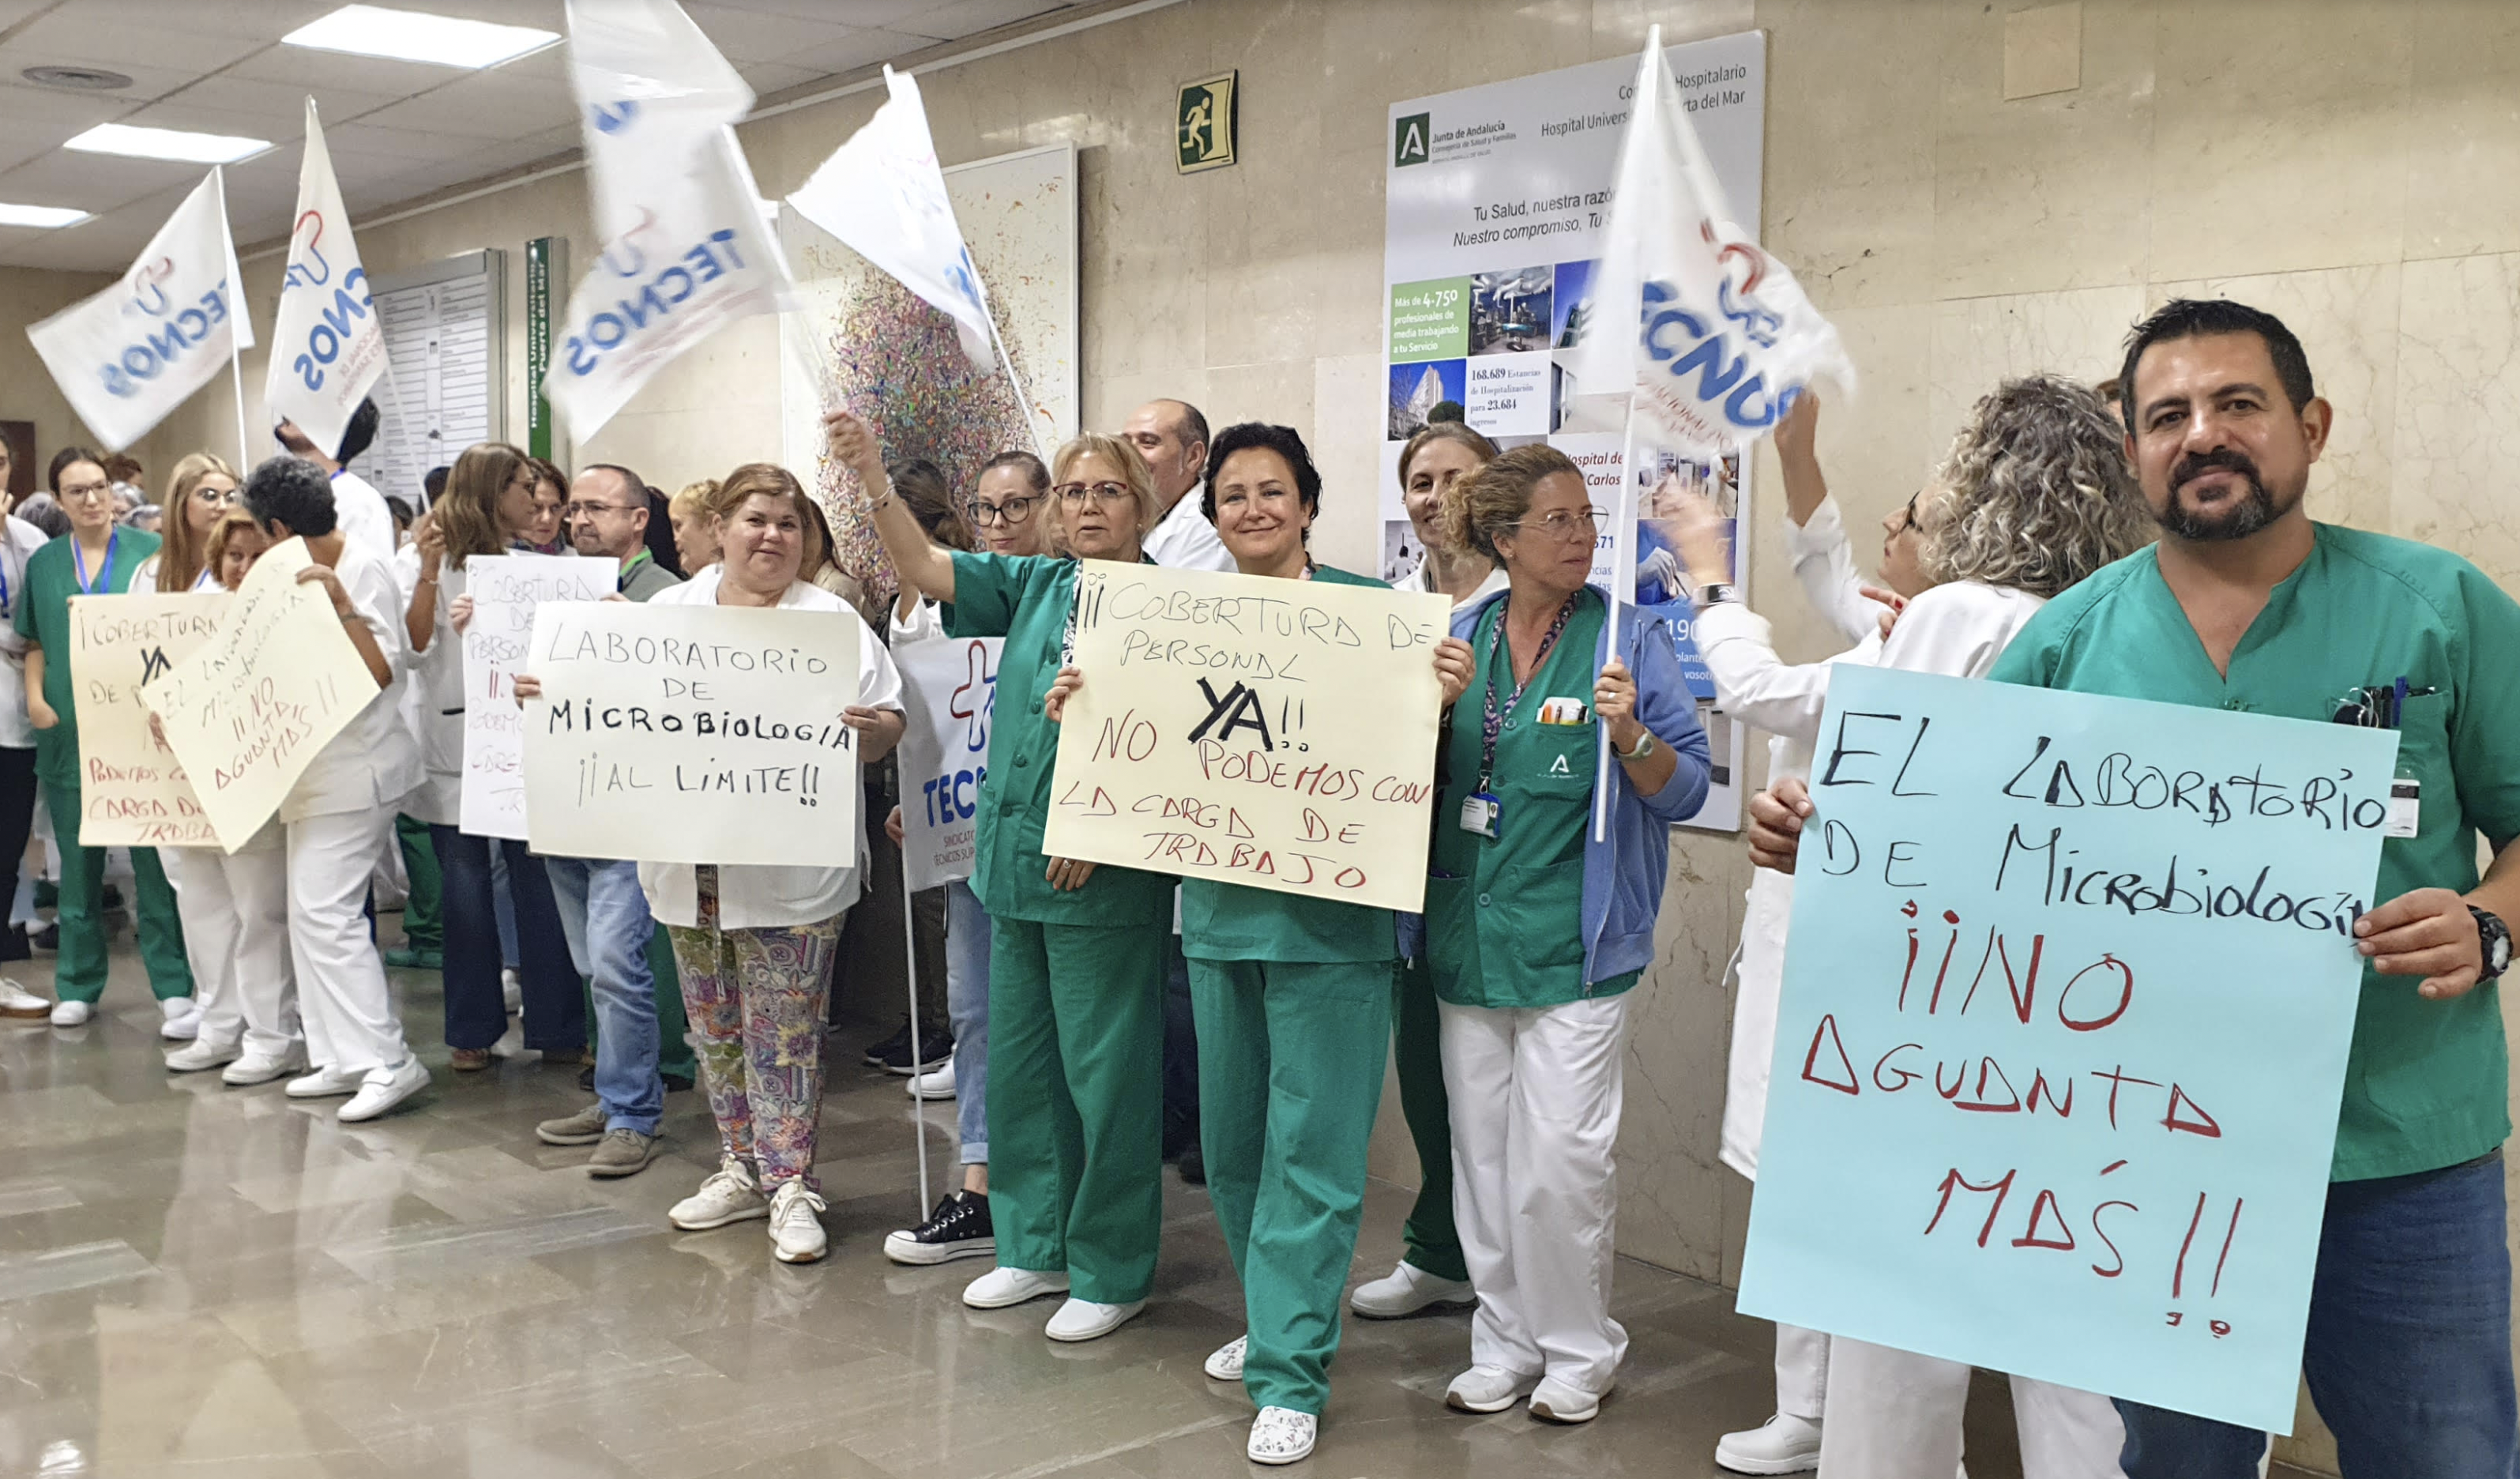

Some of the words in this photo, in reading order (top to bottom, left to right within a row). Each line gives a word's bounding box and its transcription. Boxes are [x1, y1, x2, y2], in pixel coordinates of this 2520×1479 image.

[1541, 115, 1585, 137] Hospital
[1587, 110, 1628, 130] Univers
[1701, 94, 1720, 110] del
[1722, 89, 1746, 104] Mar
[1432, 132, 1454, 144] Junta
[1455, 128, 1465, 139] de
[1466, 119, 1506, 137] Andalucía
[1474, 205, 1488, 222] Tu
[1491, 199, 1529, 220] Salud,
[1533, 196, 1581, 215] nuestra
[1454, 227, 1500, 247] Nuestro
[1503, 218, 1582, 245] compromiso,
[1589, 212, 1603, 228] Tu
[537, 262, 546, 291] Mar
[537, 294, 546, 318] del
[1395, 295, 1410, 307] Más
[1412, 295, 1421, 306] de
[1394, 311, 1444, 326] profesionales
[1445, 310, 1454, 319] de
[1394, 327, 1416, 340] media
[1418, 326, 1460, 338] trabajando
[537, 320, 547, 373] Puerta
[1400, 343, 1408, 353] tu
[1409, 341, 1439, 352] Servicio
[1472, 368, 1506, 382] 168.689
[1507, 368, 1541, 378] Estancias
[529, 365, 538, 429] Hospital
[1480, 384, 1534, 395] Hospitalización
[1488, 399, 1517, 410] 23.684
[1610, 451, 1623, 465] de
[1587, 472, 1620, 487] Carlos
[1388, 613, 1435, 652] DE
[1119, 629, 1309, 683] PERSONAL
[89, 679, 118, 705] DE
[662, 677, 716, 702] DE
[1092, 707, 1157, 763] NO
[1197, 737, 1366, 802] PODEMOS
[1819, 708, 1939, 798] EL
[1059, 779, 1117, 818] LA
[1130, 793, 1256, 840] CARGA
[1294, 807, 1367, 845] DE
[1143, 830, 1367, 890] TRABAJO
[1822, 819, 1929, 890] DE
[1800, 1013, 2223, 1139] AGUANTA
